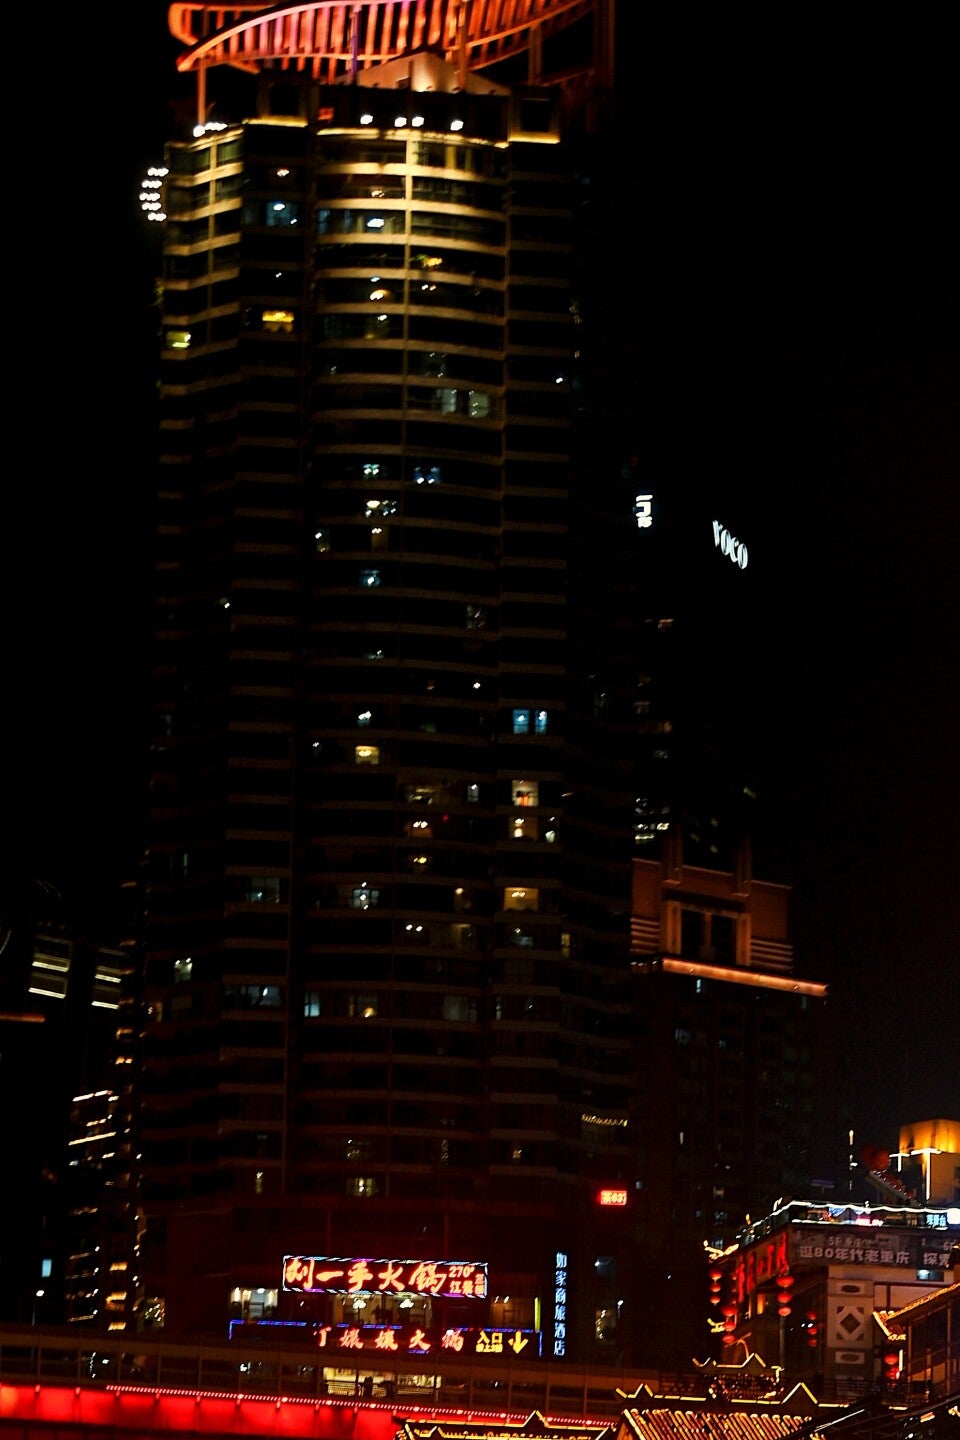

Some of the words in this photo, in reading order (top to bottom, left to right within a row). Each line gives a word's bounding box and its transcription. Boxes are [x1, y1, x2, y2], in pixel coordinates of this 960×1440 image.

[286, 1258, 447, 1293] 刘一手火锅
[554, 1252, 567, 1356] 如家商旅酒店
[477, 1331, 503, 1344] 入口
